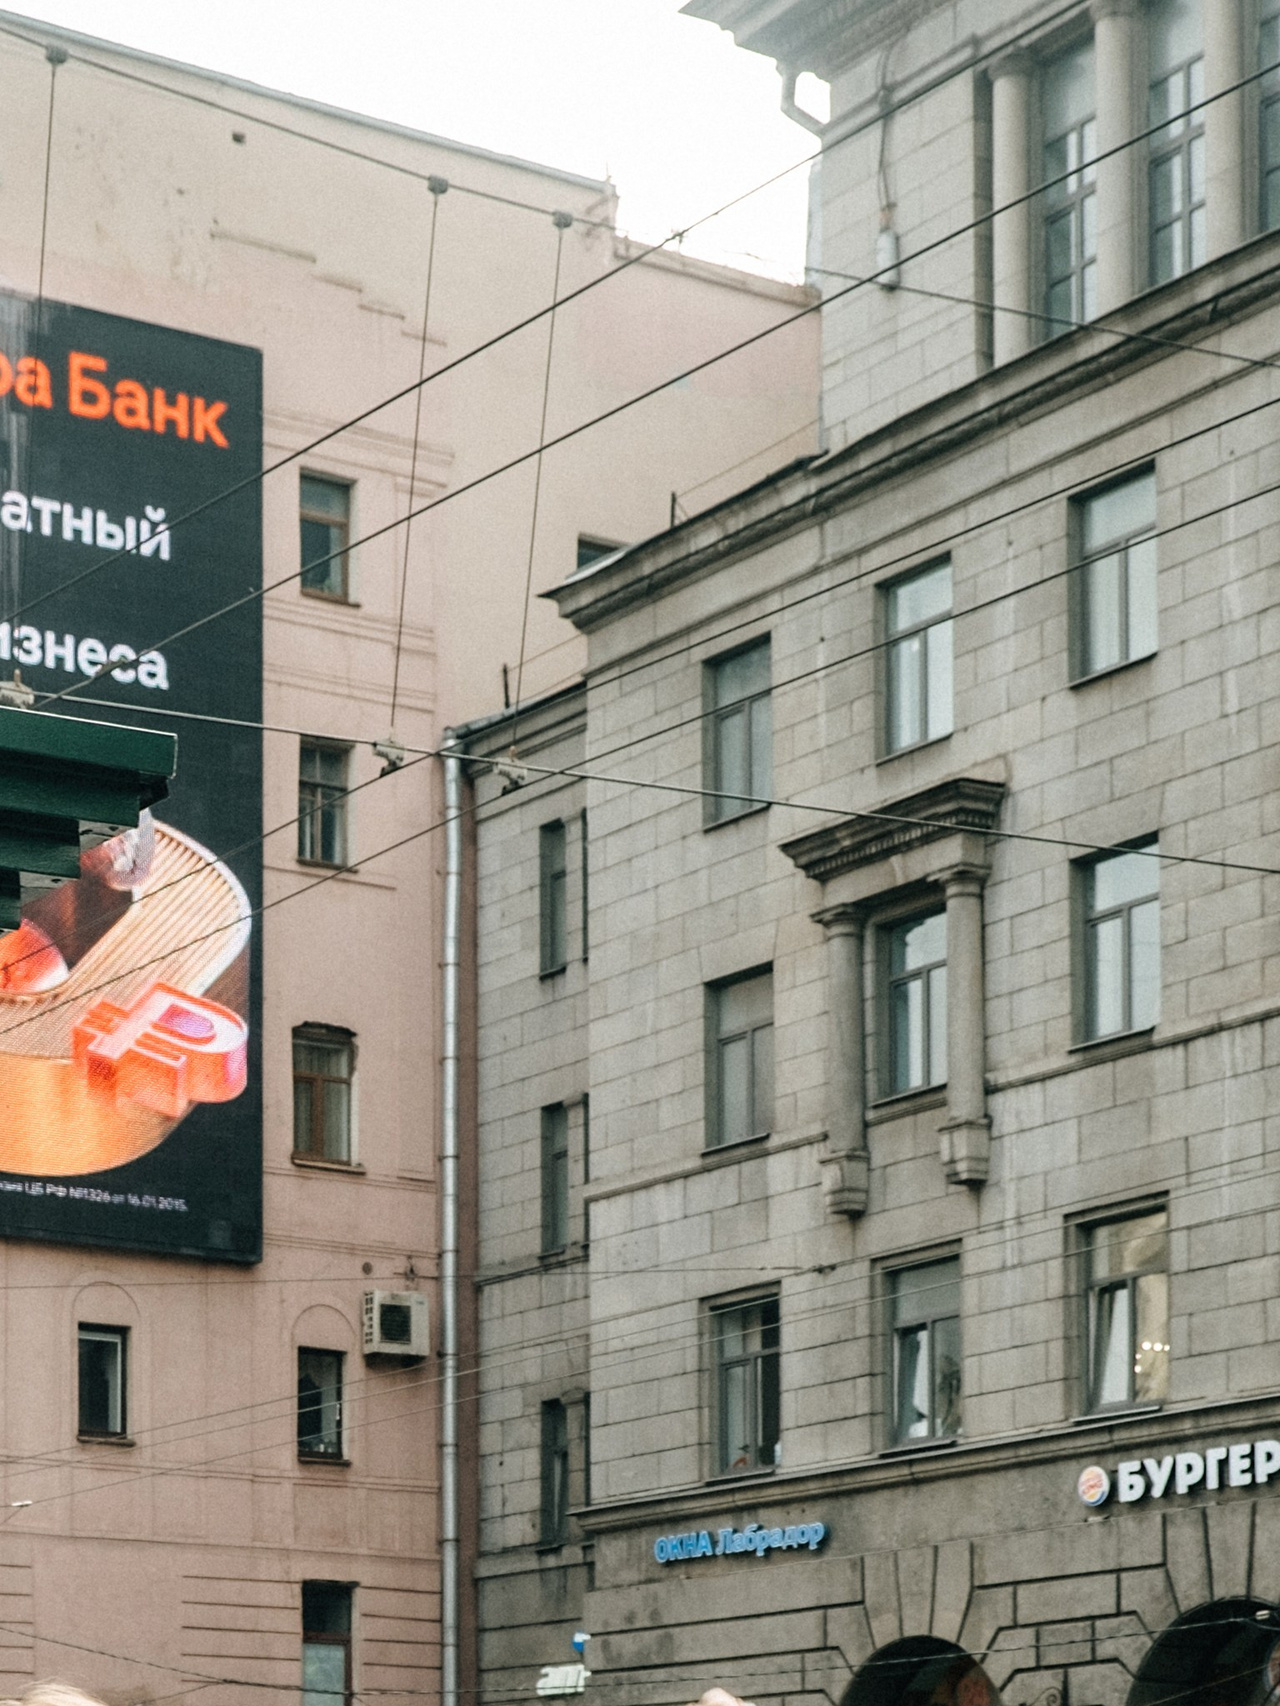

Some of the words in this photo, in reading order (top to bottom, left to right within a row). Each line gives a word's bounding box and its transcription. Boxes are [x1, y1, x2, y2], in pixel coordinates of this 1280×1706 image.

[67, 351, 230, 449] Банк
[1117, 1440, 1280, 1504] БУРГЕР
[654, 1530, 714, 1564] ОКНА
[714, 1521, 826, 1557] Лабрадор
